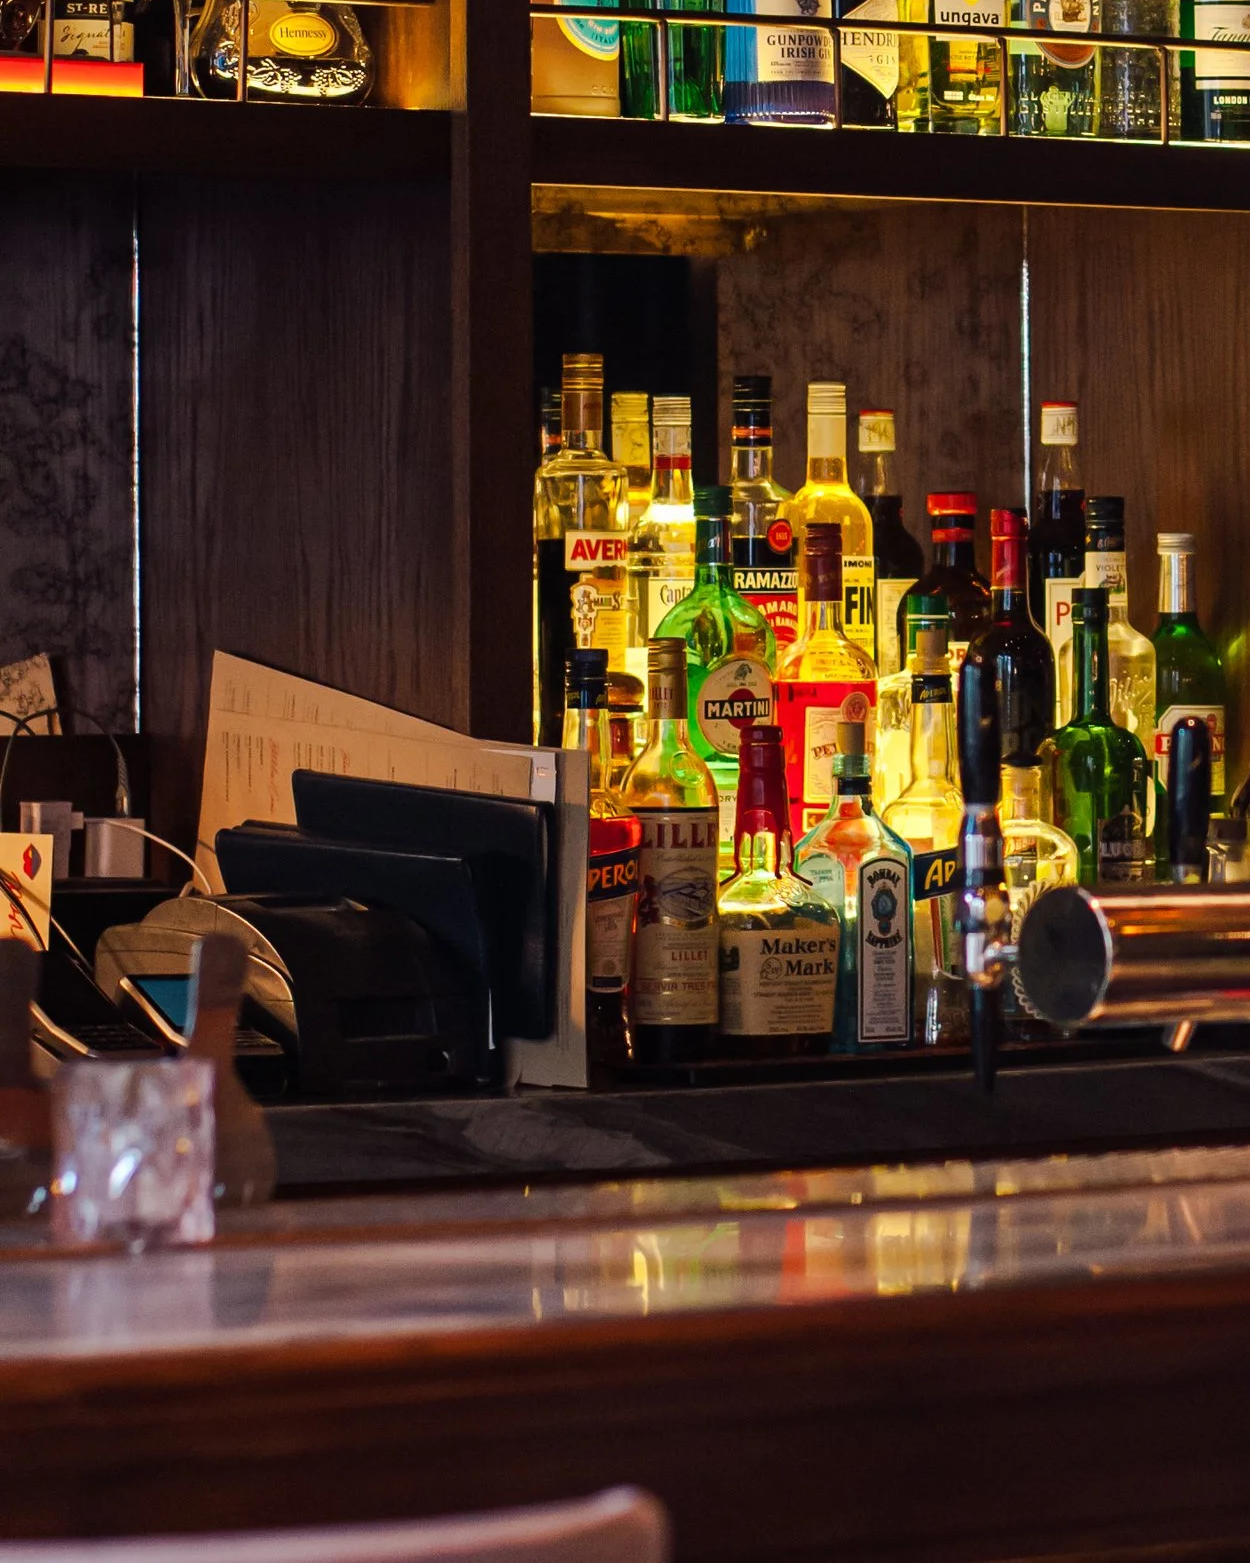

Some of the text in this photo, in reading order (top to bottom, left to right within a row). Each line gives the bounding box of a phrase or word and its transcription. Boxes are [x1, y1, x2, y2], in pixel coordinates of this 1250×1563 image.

[940, 11, 1000, 26] ungava
[279, 26, 328, 41] Hennessy
[781, 46, 815, 59] IRISH
[1213, 95, 1248, 105] LONDON
[707, 700, 769, 718] MARTINI
[924, 858, 956, 891] AP
[760, 937, 837, 955] Maker's
[671, 950, 709, 961] LILLET
[784, 957, 835, 977] Mark
